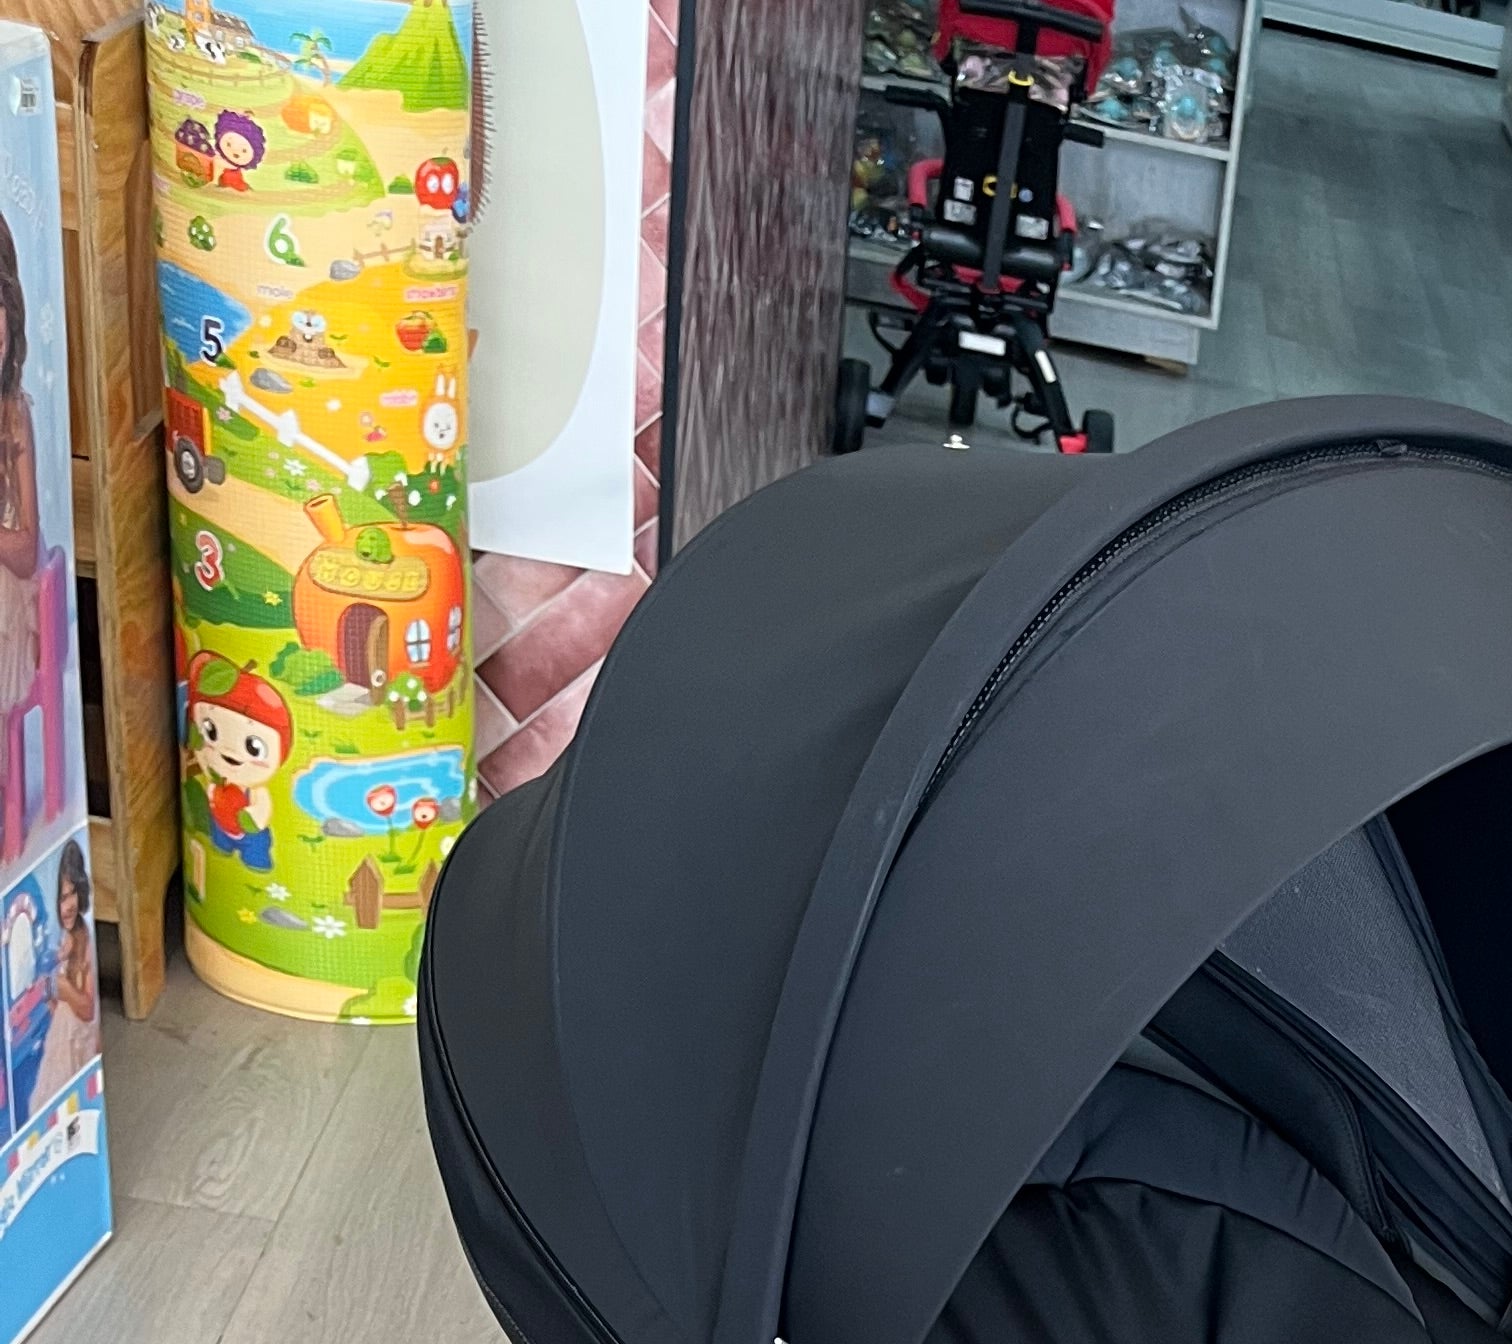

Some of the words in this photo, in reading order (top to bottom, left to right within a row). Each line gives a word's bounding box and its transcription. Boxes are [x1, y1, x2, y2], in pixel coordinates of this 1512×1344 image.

[266, 214, 302, 268] 6
[199, 314, 226, 367] 5
[194, 530, 224, 592] 3
